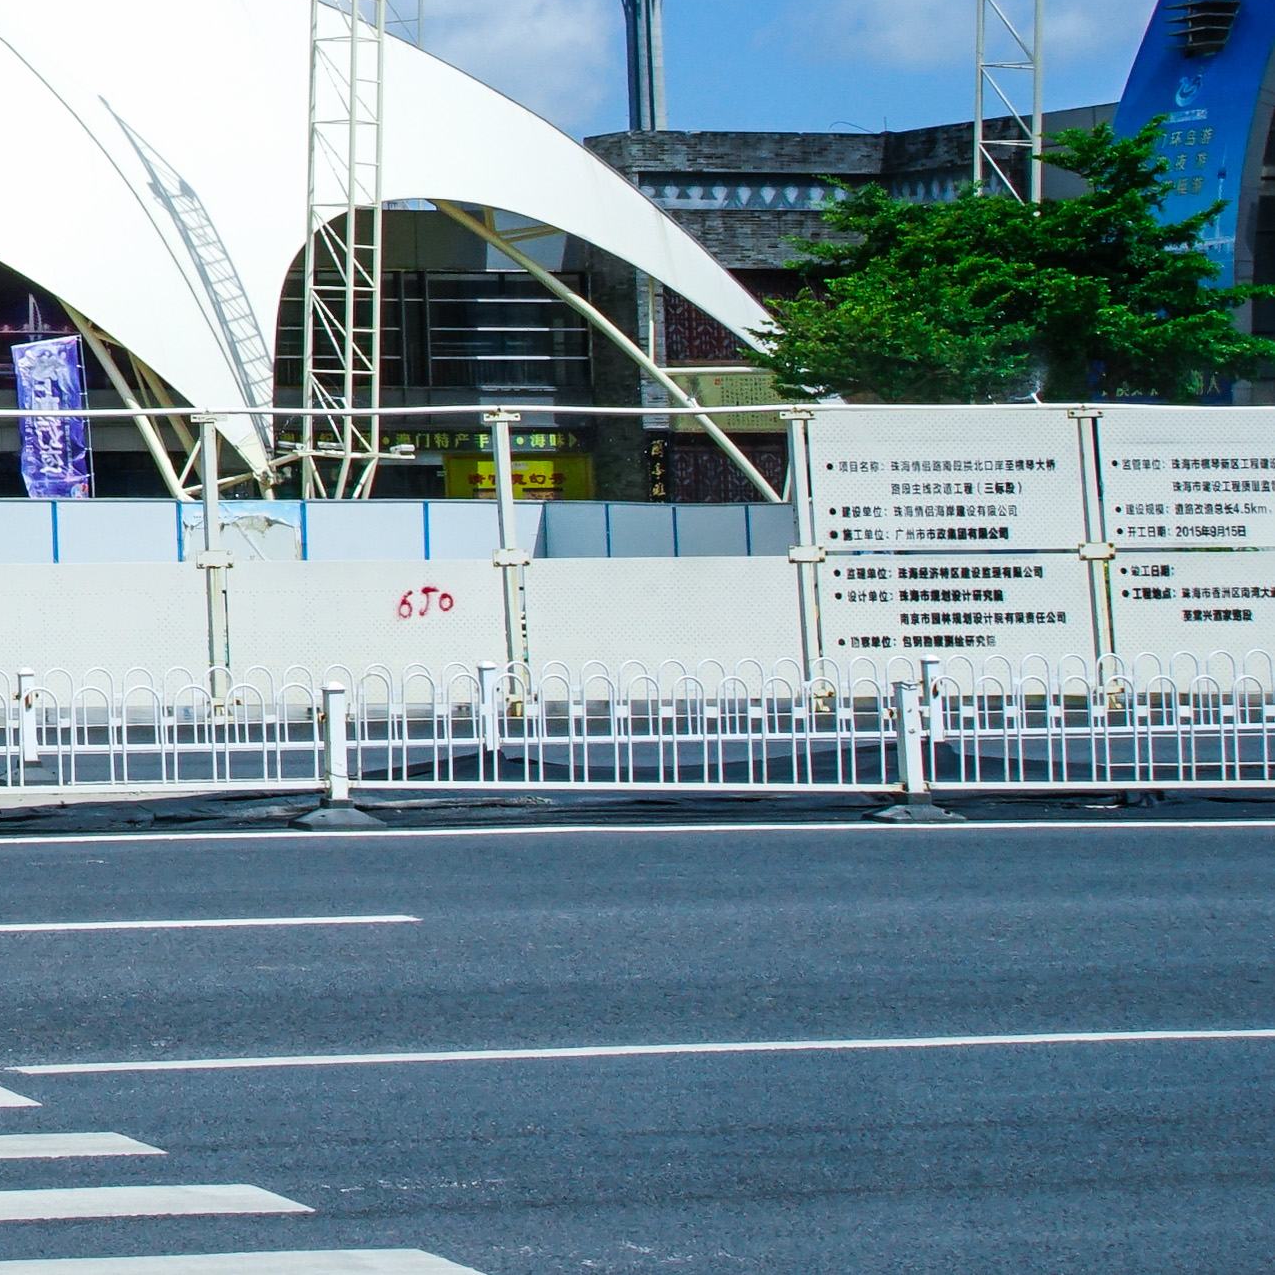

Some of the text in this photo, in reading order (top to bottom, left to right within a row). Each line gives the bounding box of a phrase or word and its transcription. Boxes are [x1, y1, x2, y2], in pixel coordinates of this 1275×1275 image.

[395, 432, 489, 449] 澳门特产手
